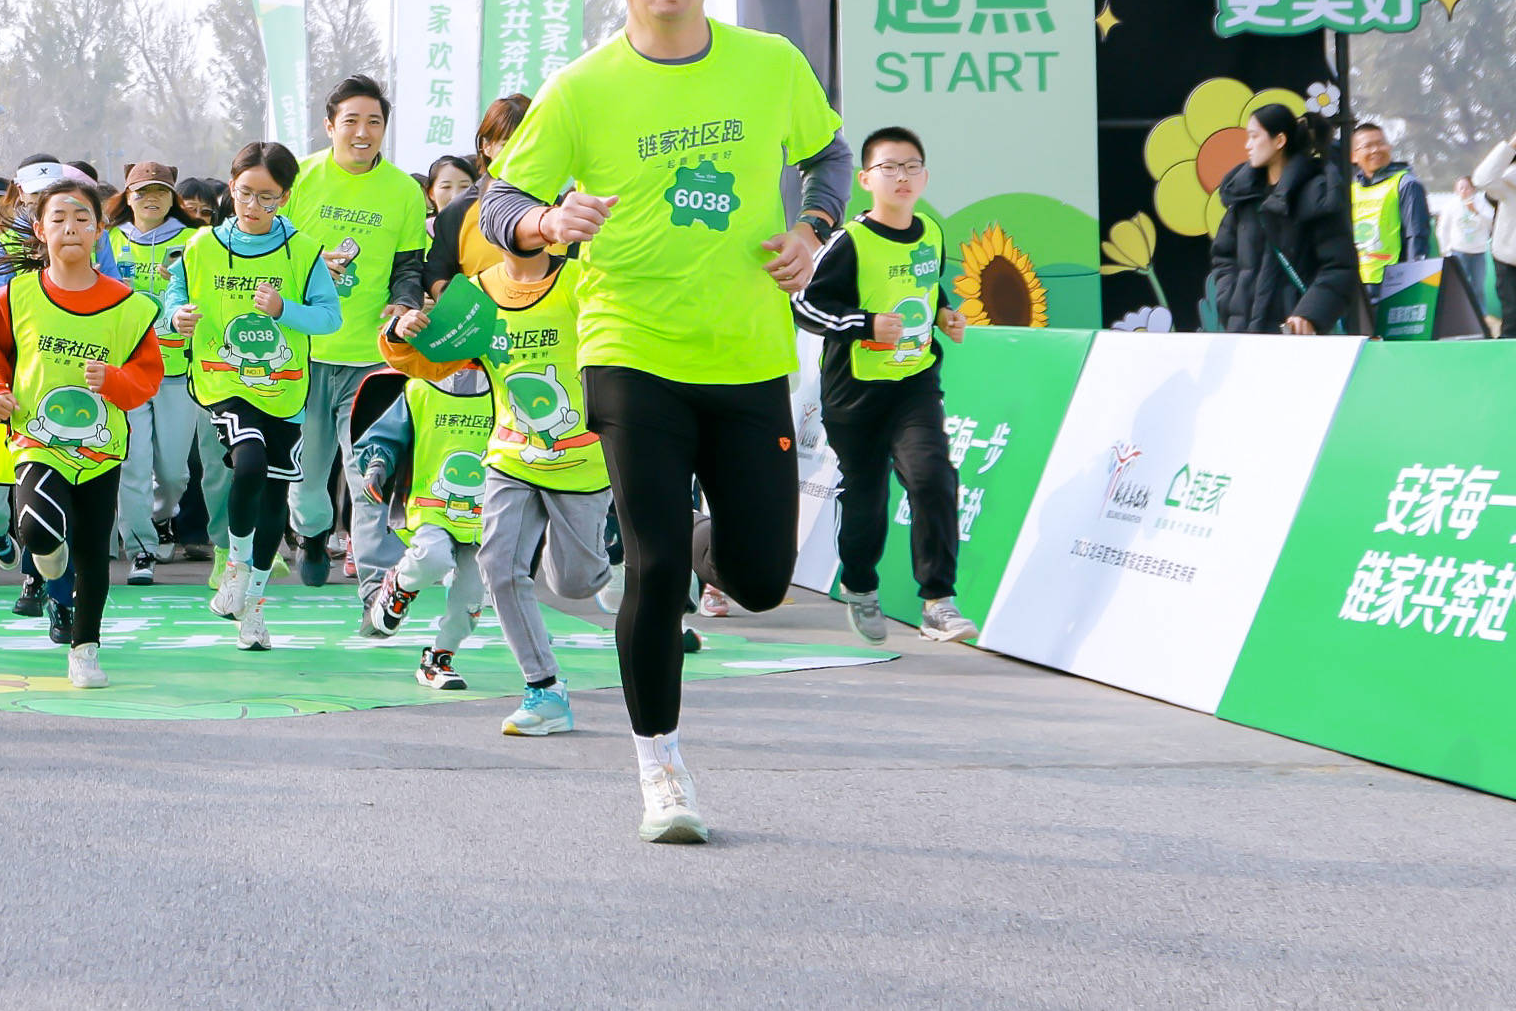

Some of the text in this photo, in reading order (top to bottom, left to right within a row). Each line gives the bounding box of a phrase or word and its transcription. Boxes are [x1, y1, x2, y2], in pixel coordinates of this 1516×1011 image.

[874, 52, 1060, 93] START
[637, 119, 745, 161] 链家社区跑
[320, 205, 383, 227] 链家社区跑
[674, 188, 731, 212] 6038
[238, 329, 275, 343] 6038
[1373, 463, 1516, 544] 安家每一
